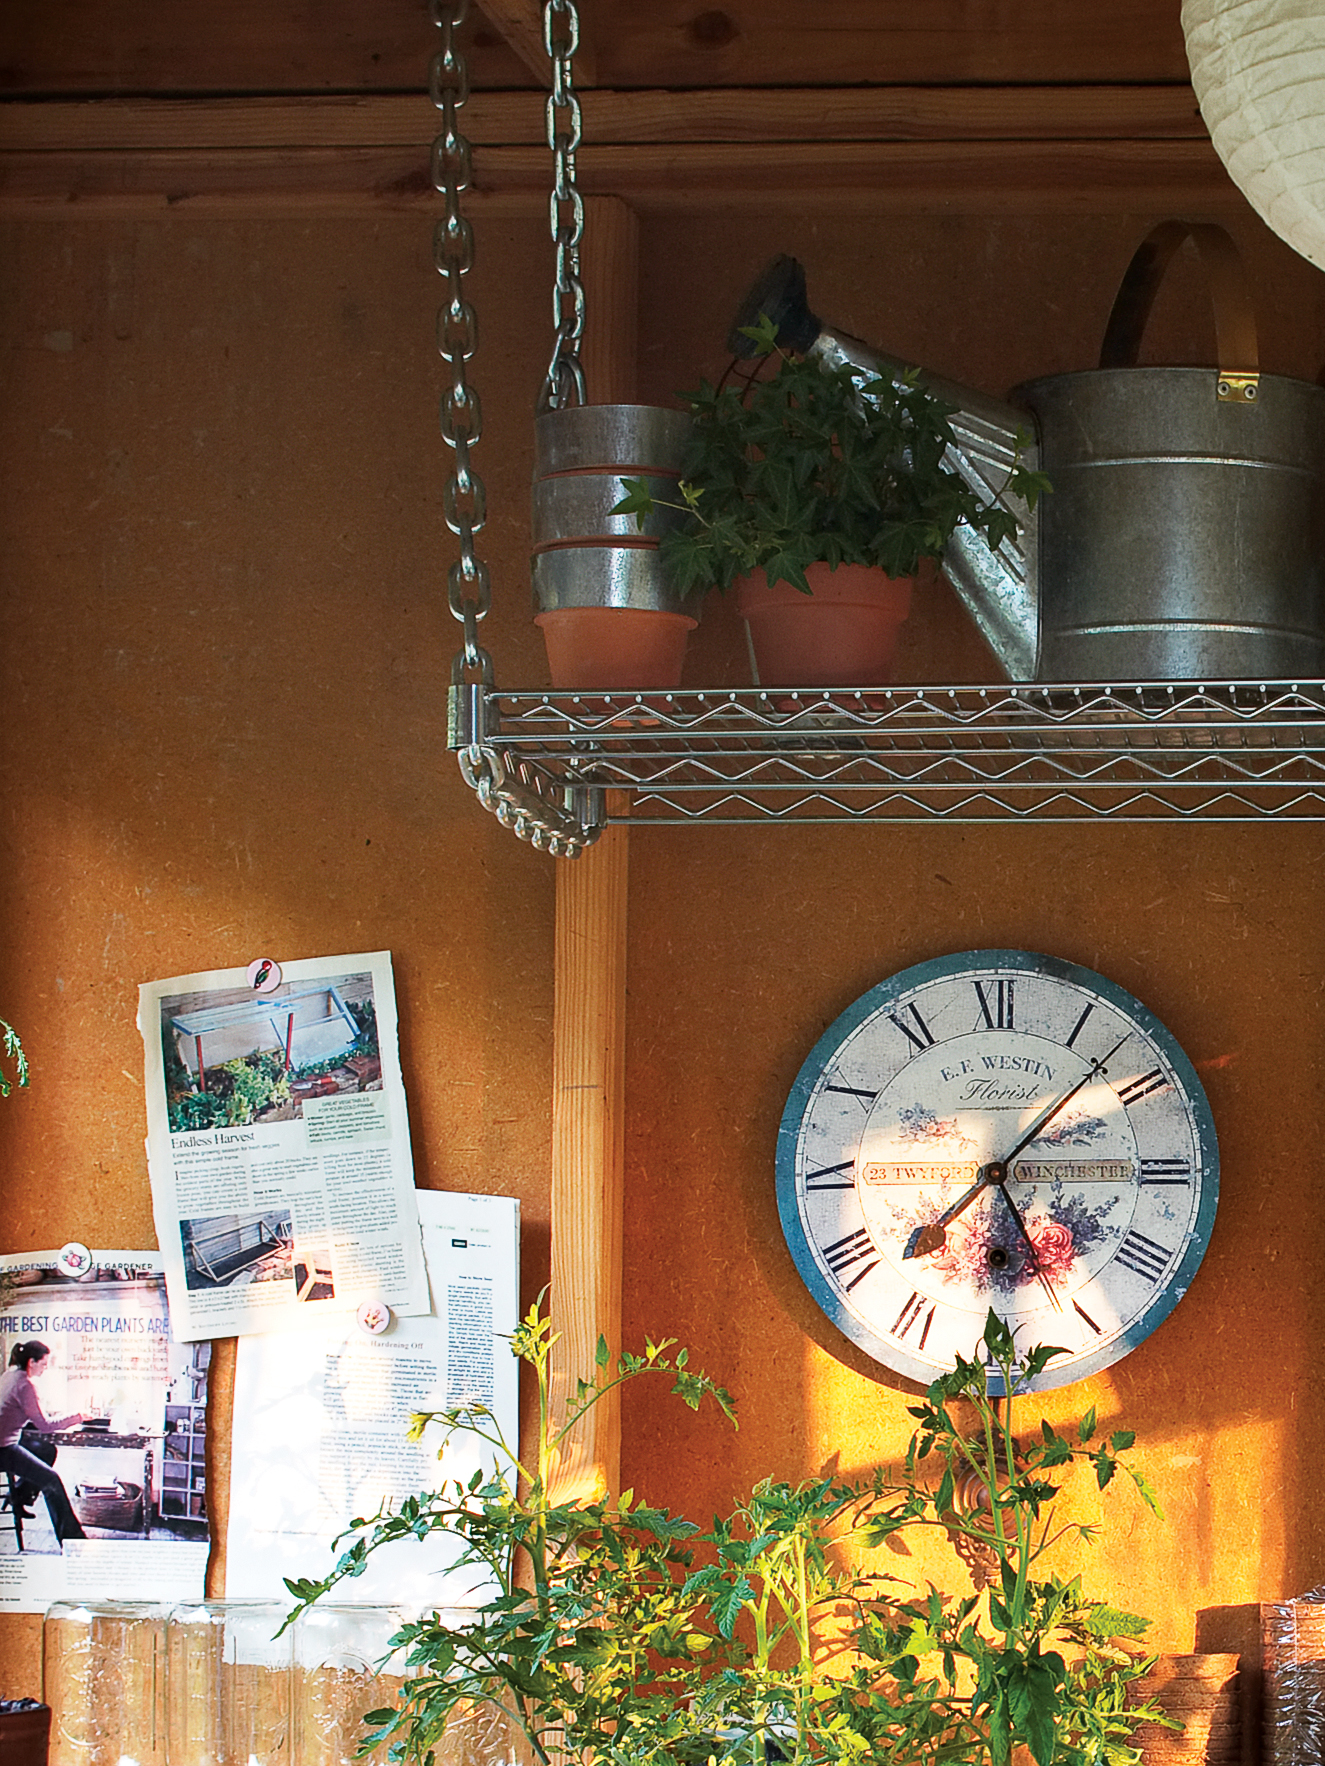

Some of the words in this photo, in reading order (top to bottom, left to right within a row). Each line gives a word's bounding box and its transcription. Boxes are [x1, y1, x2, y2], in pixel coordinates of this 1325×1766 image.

[972, 980, 1017, 1031] XII
[981, 1055, 1058, 1081] WESTIN
[959, 1078, 1040, 1101] Florist
[171, 1136, 212, 1149] Endless
[214, 1131, 255, 1145] Harvest
[868, 1168, 888, 1181] 23
[894, 1166, 976, 1181] TWYFORD
[1018, 1165, 1130, 1179] WINCHESTER
[7, 1262, 58, 1272] GARDENING
[104, 1262, 153, 1270] GARDENER
[0, 1316, 20, 1333] THE
[22, 1316, 50, 1332] BEST
[52, 1316, 98, 1332] GARDEN
[101, 1317, 144, 1334] PLANTS
[370, 1340, 410, 1350] Hardening
[410, 1342, 424, 1350] Off
